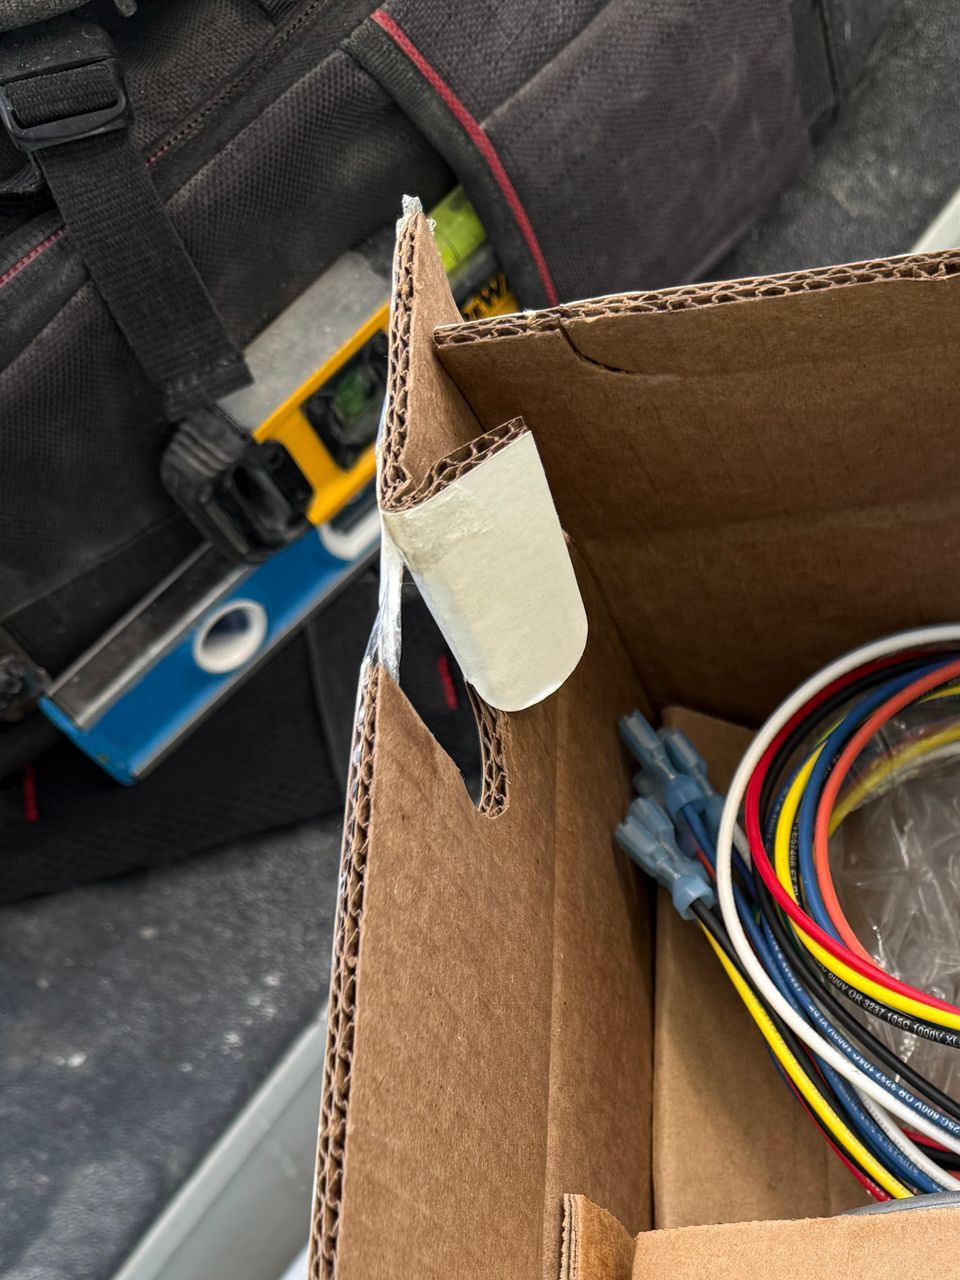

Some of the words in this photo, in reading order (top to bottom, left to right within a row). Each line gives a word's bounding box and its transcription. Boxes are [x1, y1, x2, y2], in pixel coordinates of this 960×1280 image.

[848, 990, 863, 1004] OR
[863, 999, 885, 1016] 3237
[913, 1023, 944, 1040] 1000V
[898, 1089, 914, 1103] OR
